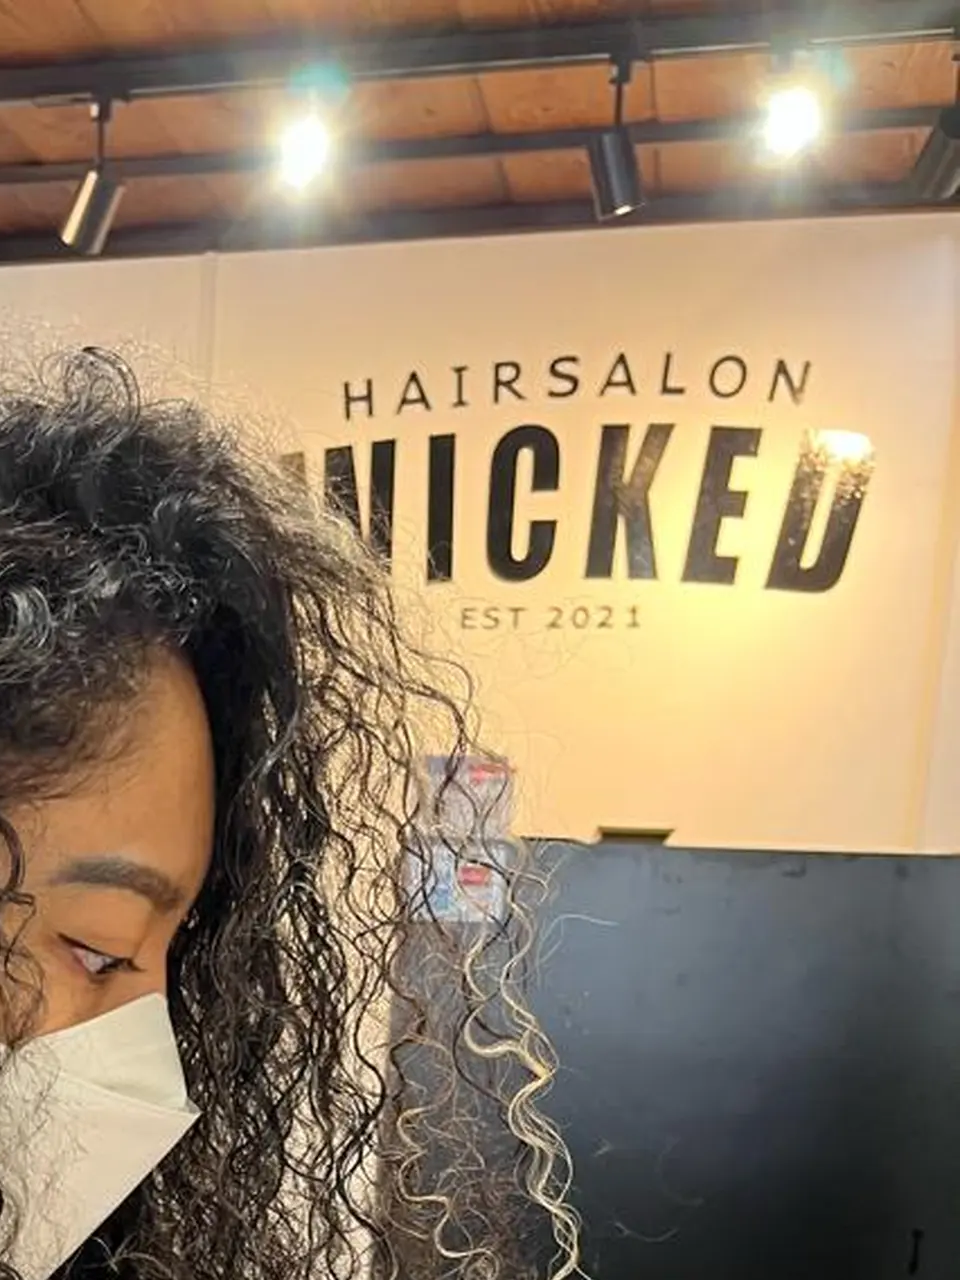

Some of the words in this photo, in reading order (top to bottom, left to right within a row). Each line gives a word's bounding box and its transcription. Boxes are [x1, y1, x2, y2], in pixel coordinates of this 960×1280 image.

[343, 352, 813, 420] HAIRSALON
[460, 606, 526, 630] EST
[545, 605, 640, 630] 2021
